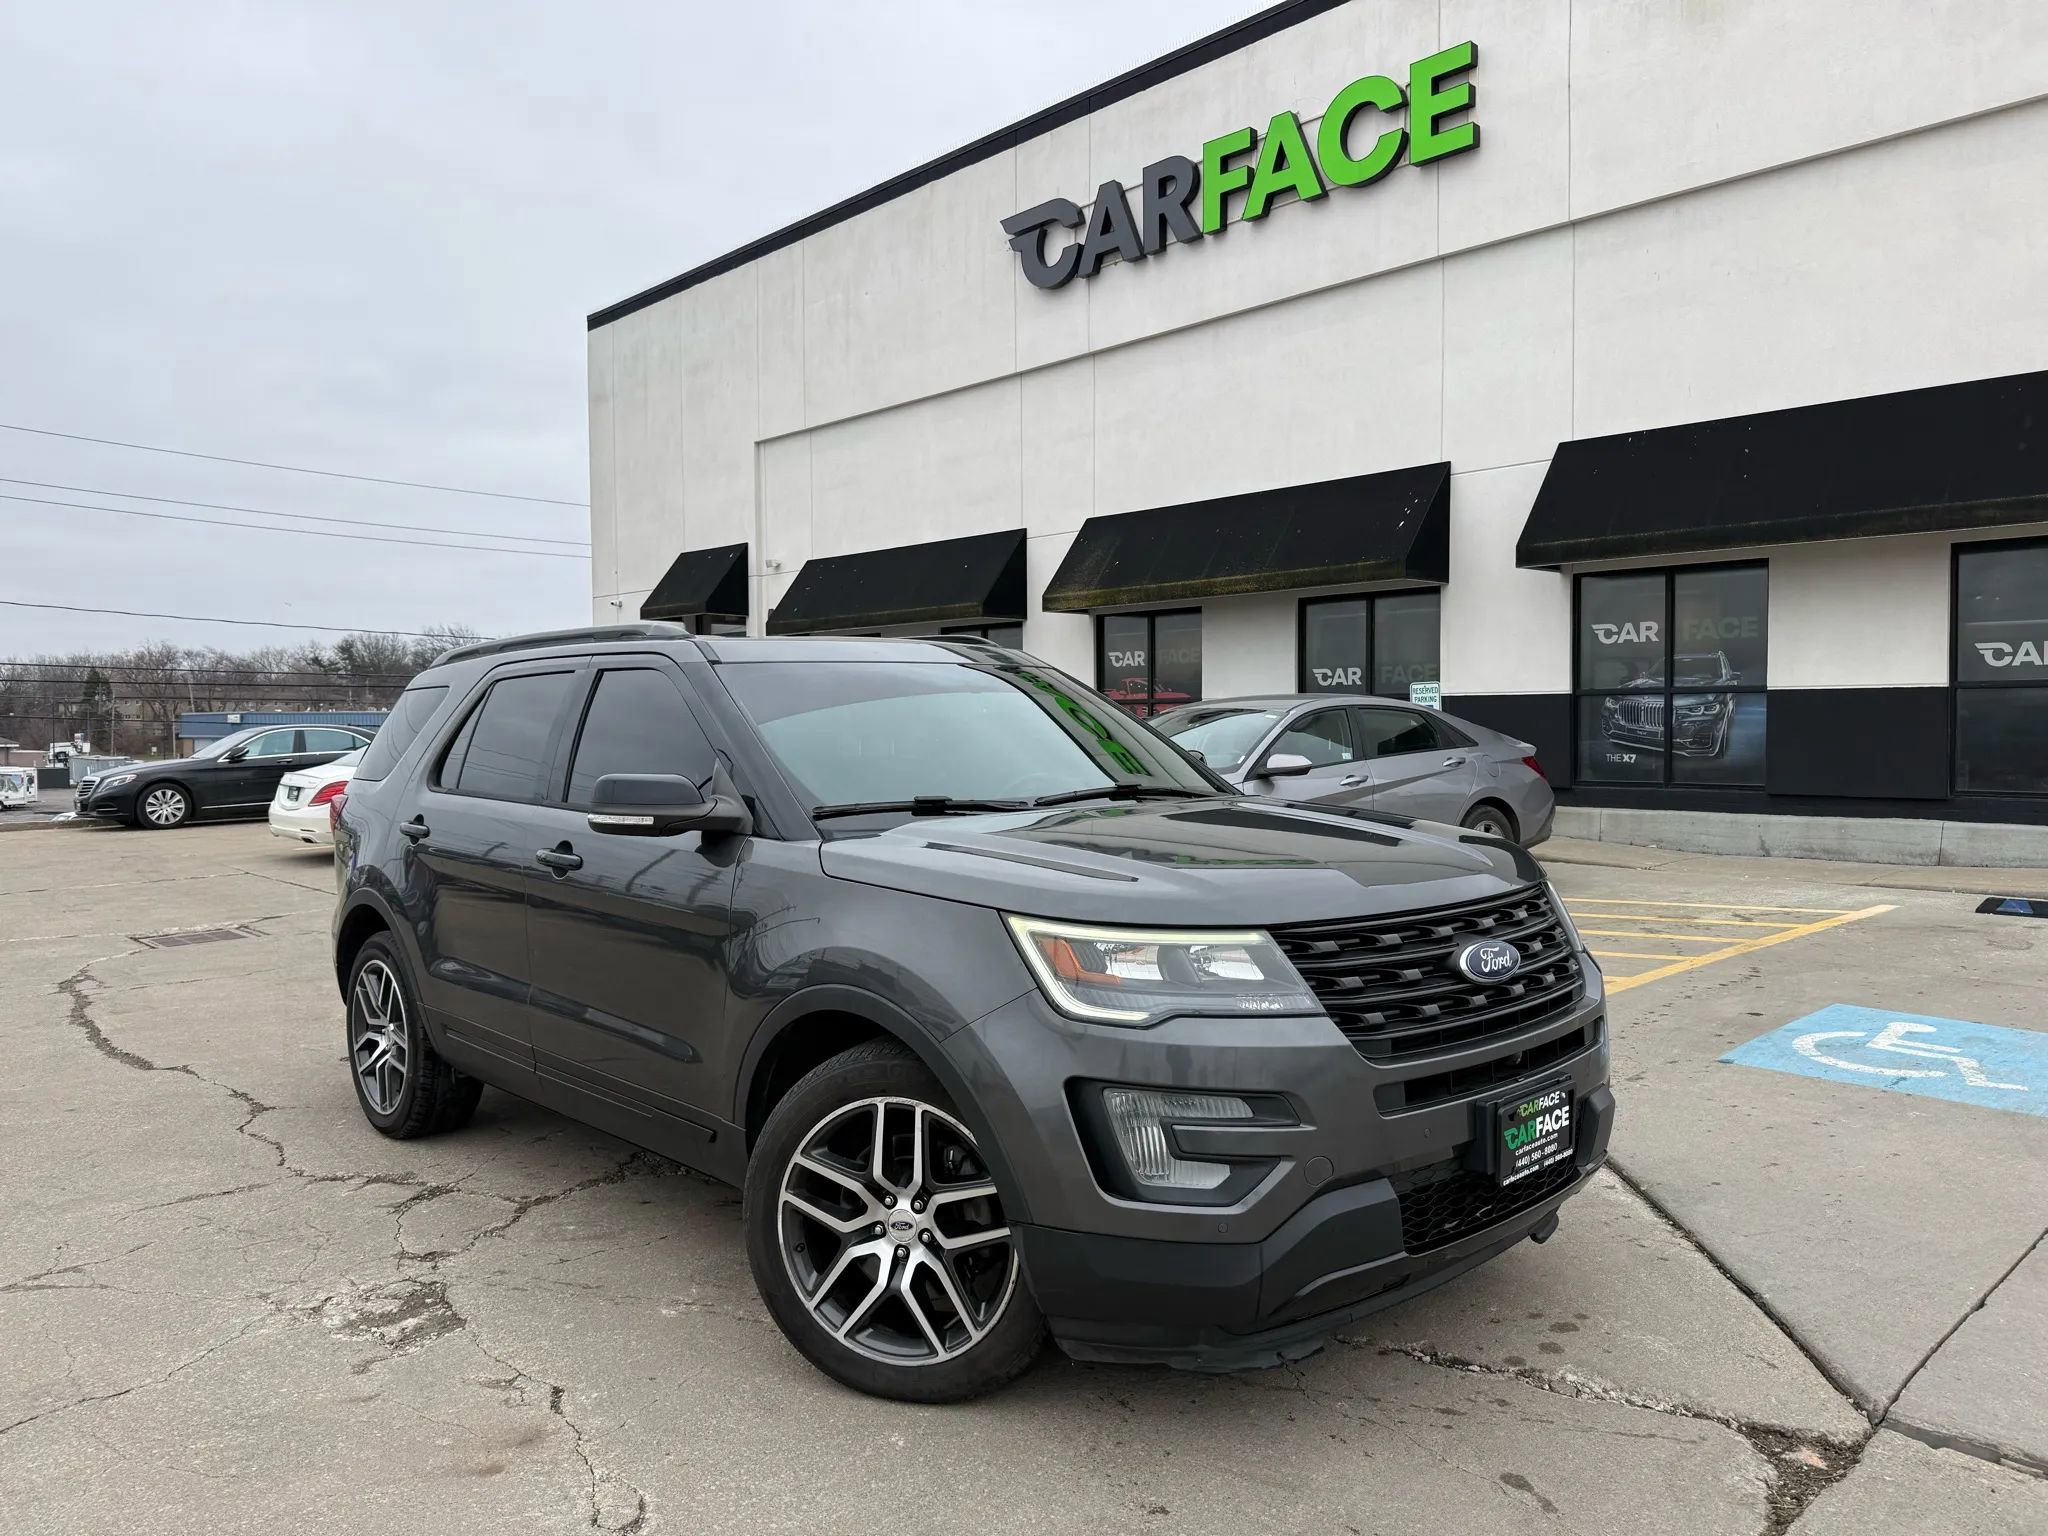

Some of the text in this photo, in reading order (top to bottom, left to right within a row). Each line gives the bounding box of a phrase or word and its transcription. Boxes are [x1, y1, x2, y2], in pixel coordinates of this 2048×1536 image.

[1000, 40, 1480, 290] CARFACE
[1591, 616, 1759, 645] CAR FACE
[1107, 650, 1145, 667] CAR
[1974, 640, 2048, 667] CA
[1312, 667, 1362, 686] CAR
[1412, 686, 1439, 695] RESERVED
[1414, 695, 1437, 703] PARKING
[1606, 753, 1637, 763] THE X7
[1480, 946, 1512, 972] Ford
[1519, 1090, 1560, 1117] CARFACE
[1503, 1105, 1570, 1150] CARFACE
[1515, 1132, 1558, 1156] carfaceauto.com
